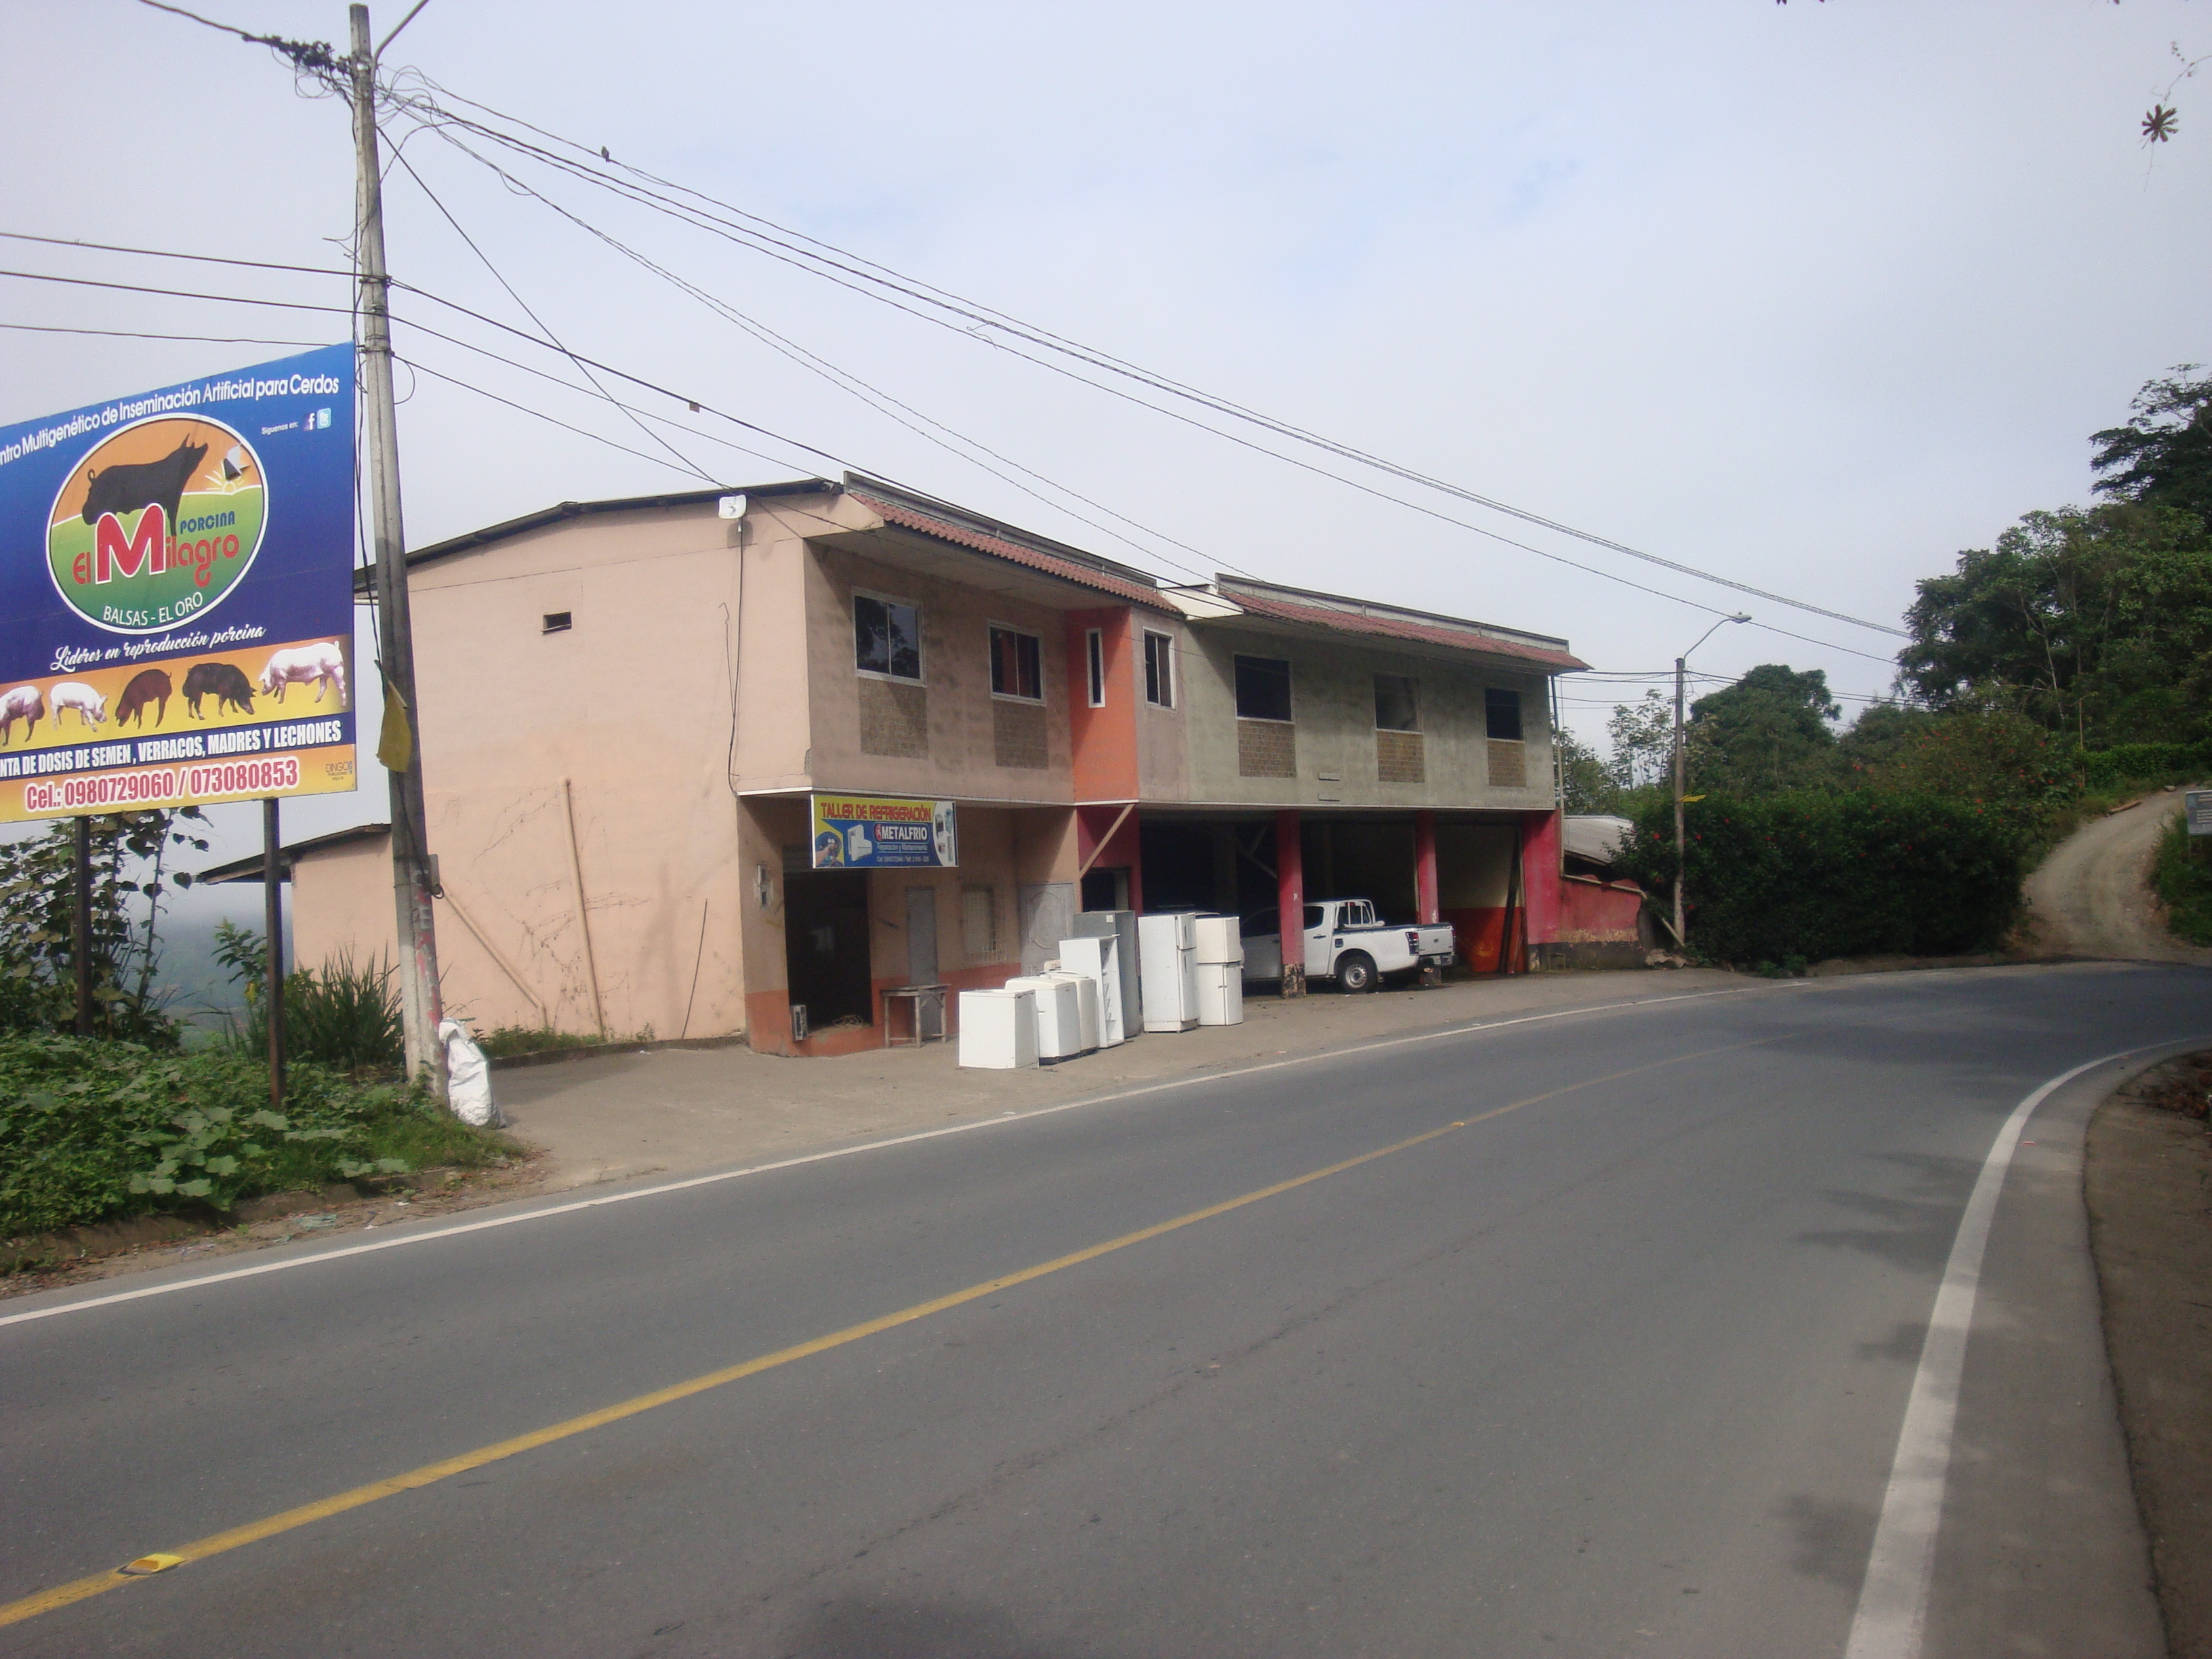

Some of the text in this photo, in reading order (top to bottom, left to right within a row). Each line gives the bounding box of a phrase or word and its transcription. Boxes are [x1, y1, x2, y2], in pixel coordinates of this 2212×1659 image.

[22, 415, 100, 455] Multigenético
[102, 406, 119, 426] de
[119, 384, 201, 421] Inseminación
[202, 377, 255, 403] Artificial
[255, 379, 289, 401] para
[290, 373, 340, 394] Cerdos
[180, 510, 235, 535] PORCINA
[95, 502, 239, 588] Milagro
[103, 605, 148, 626] BALSAS
[159, 607, 173, 623] EL
[175, 592, 203, 617] ORO
[104, 648, 121, 660] en
[123, 630, 210, 659] reproducción
[209, 623, 267, 649] porcina
[22, 754, 37, 775] DE
[38, 750, 73, 773] DOSIS
[75, 748, 91, 769] DE
[91, 743, 131, 768] SEMEN
[138, 735, 206, 762] VERRACOS,
[207, 729, 261, 755] MADRES
[262, 728, 272, 749] Y
[274, 720, 342, 748] LECHONES
[26, 783, 62, 811] Cel.:
[64, 771, 175, 807] 0980729060
[190, 758, 298, 795] 073080853
[821, 802, 931, 821] TALLER DE REFRIGERACIÓN
[882, 825, 928, 840] METALFRIO
